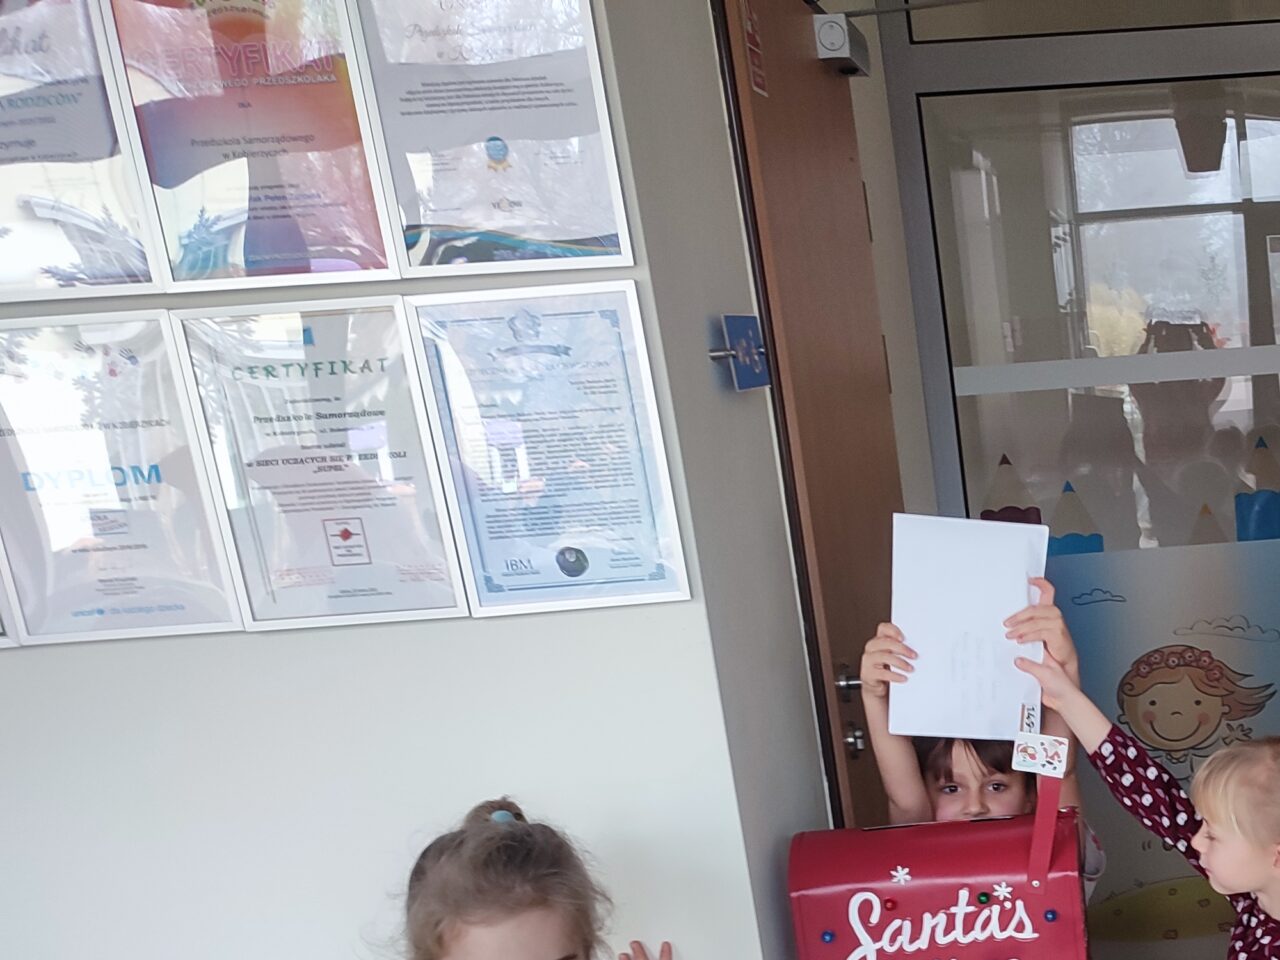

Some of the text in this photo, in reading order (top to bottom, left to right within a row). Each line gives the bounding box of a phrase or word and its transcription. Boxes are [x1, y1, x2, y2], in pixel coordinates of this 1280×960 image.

[231, 357, 389, 382] CERTYFIKAT
[21, 463, 163, 492] DYPLOM
[504, 558, 535, 572] IBM
